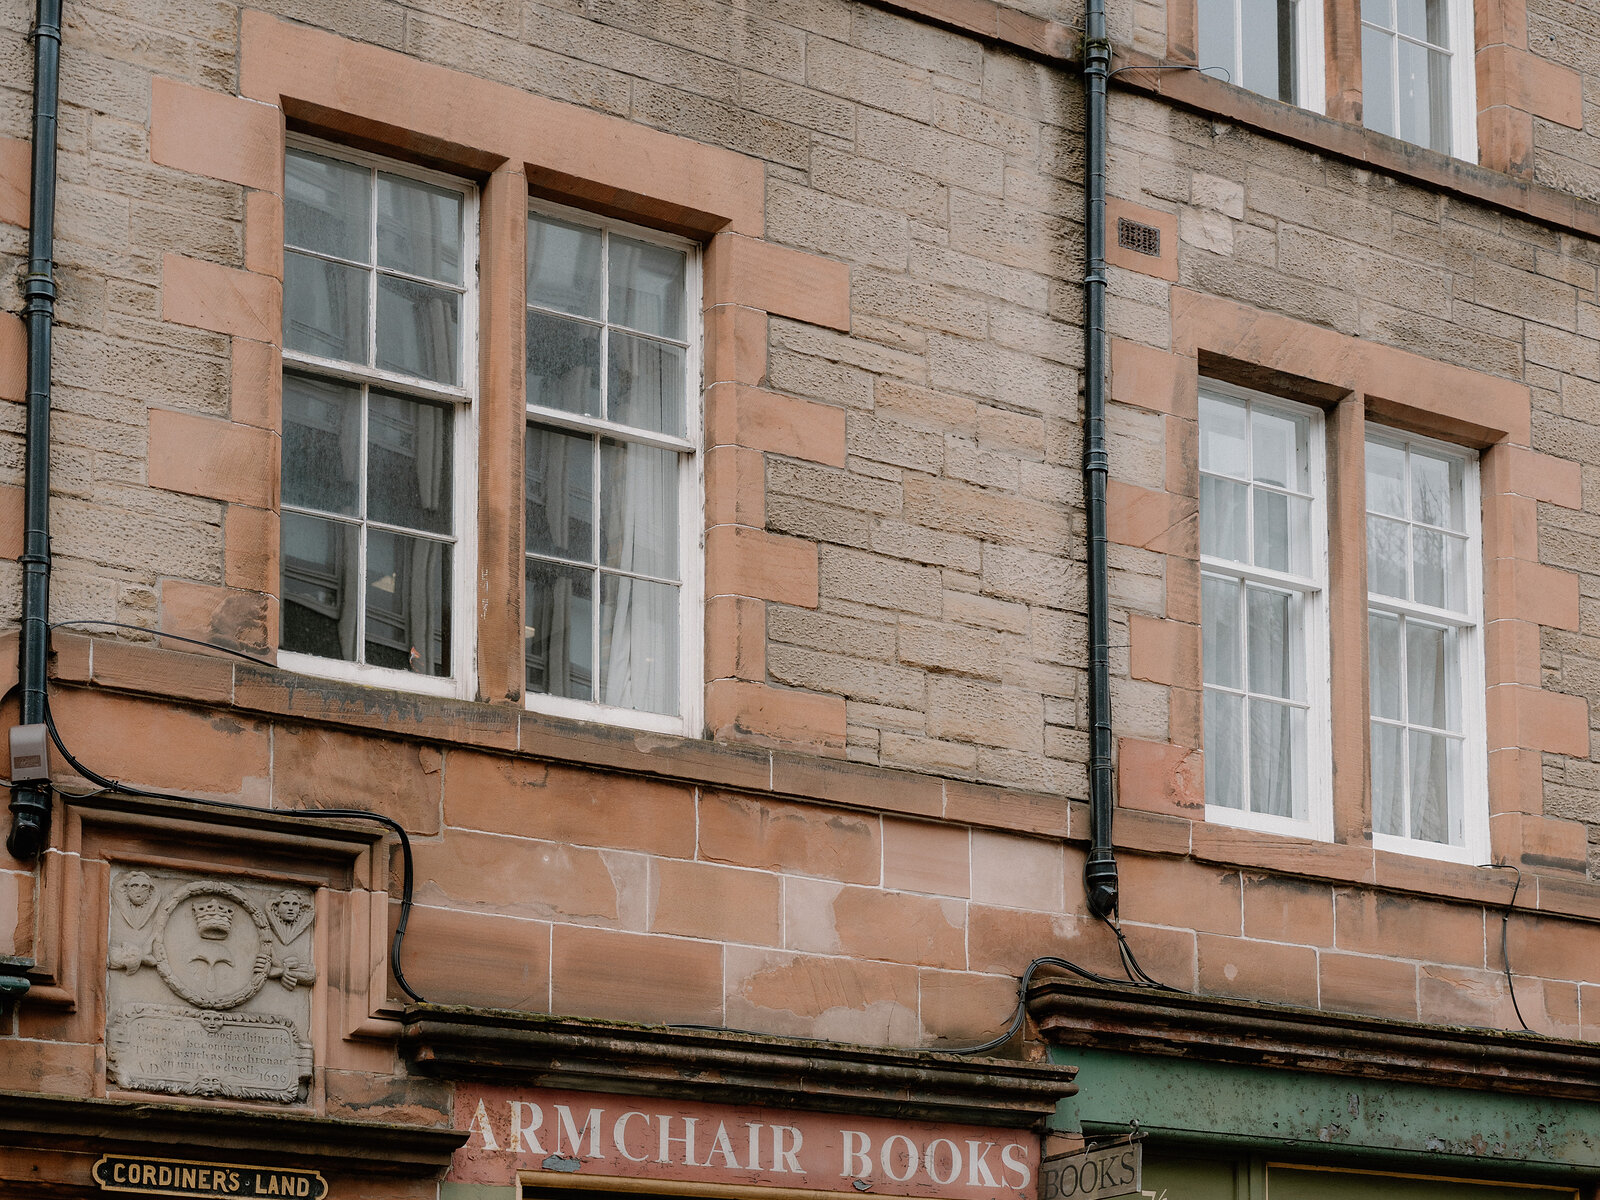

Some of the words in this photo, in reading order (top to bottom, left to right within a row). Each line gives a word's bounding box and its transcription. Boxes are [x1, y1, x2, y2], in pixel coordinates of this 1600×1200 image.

[259, 1070, 288, 1086] 1696
[461, 1097, 807, 1175] ARMCHAIR
[839, 1129, 1032, 1192] BOOKS
[112, 1162, 241, 1193] CORDINER'S
[255, 1173, 310, 1198] LAND
[1042, 1151, 1135, 1200] BOOKS
